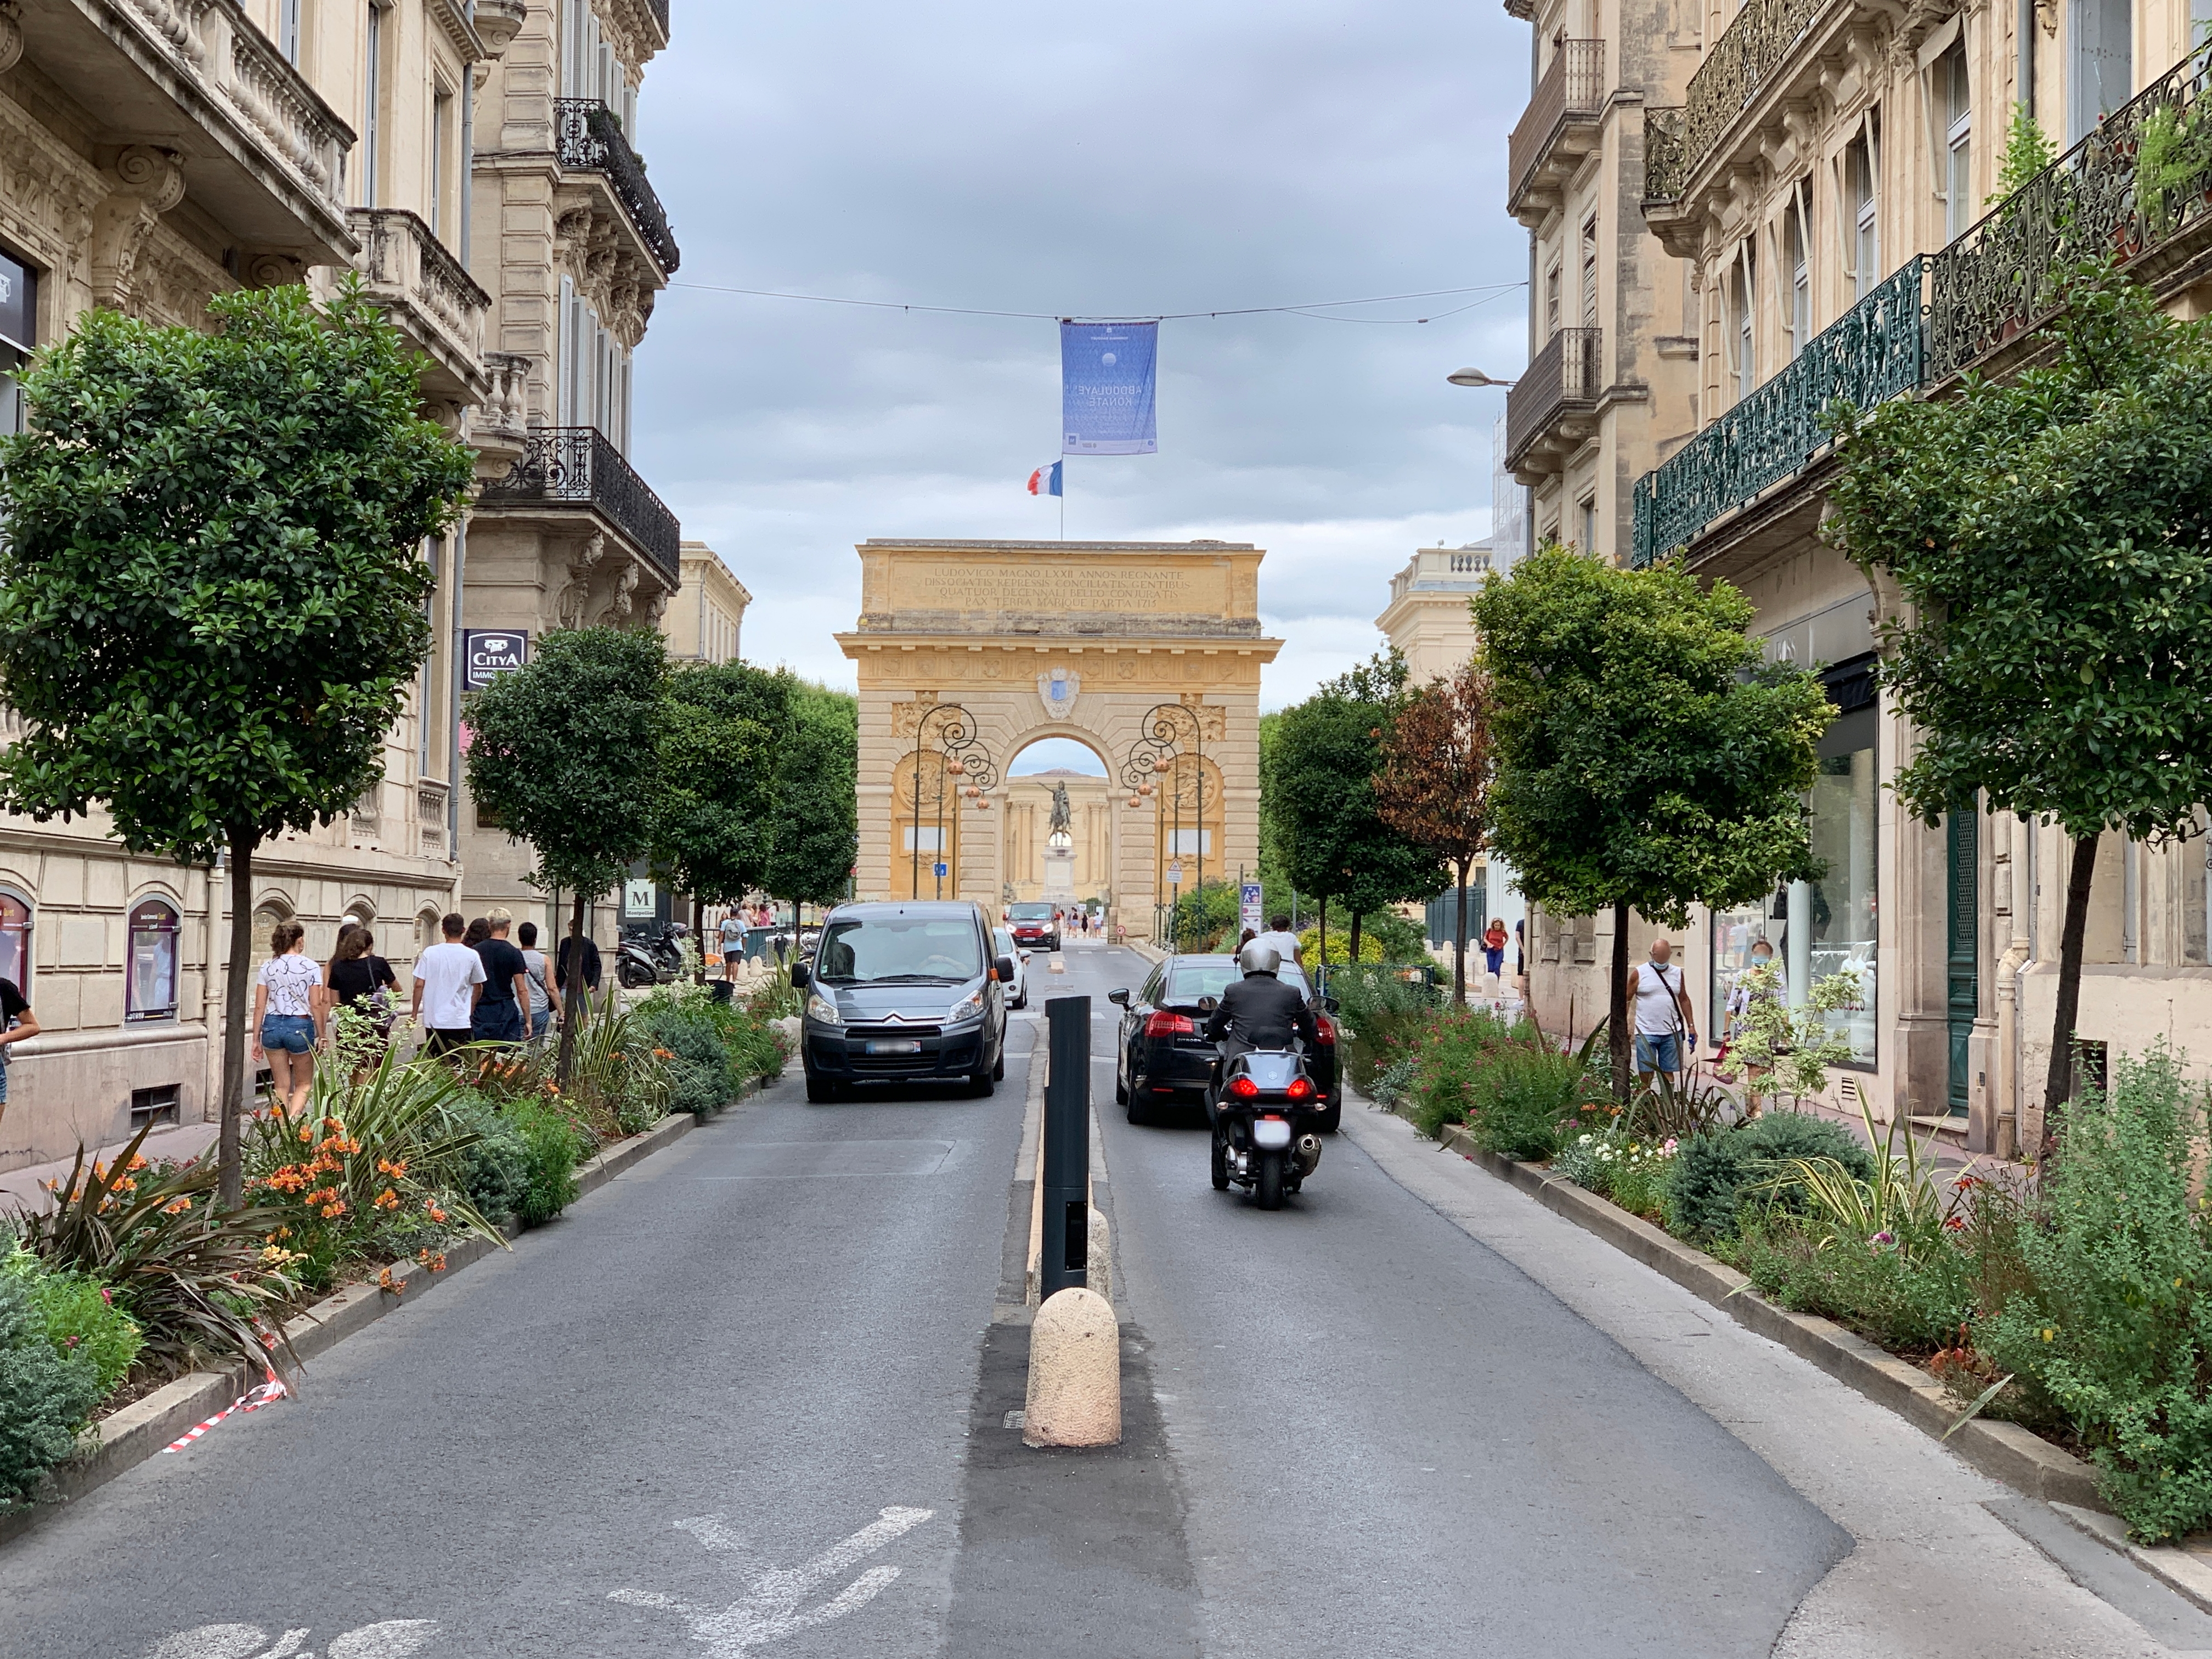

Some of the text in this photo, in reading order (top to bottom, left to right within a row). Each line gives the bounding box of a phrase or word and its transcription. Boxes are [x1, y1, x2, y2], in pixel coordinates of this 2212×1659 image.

[934, 568, 1184, 580] LUDOVICO MAGNO LXXII ANNOS REGNANTE
[924, 578, 1190, 589] DISSOCIATIS REPRESSIS CONCILIATIS GENTIBUS
[940, 587, 1178, 599] QUATUOR DECENNALI BELLO CONJURATIS
[965, 597, 988, 606] PAX
[994, 597, 1031, 606] TERRA
[1037, 598, 1087, 608] MARIQUE
[1093, 599, 1131, 607] PARTA
[631, 891, 650, 906] M
